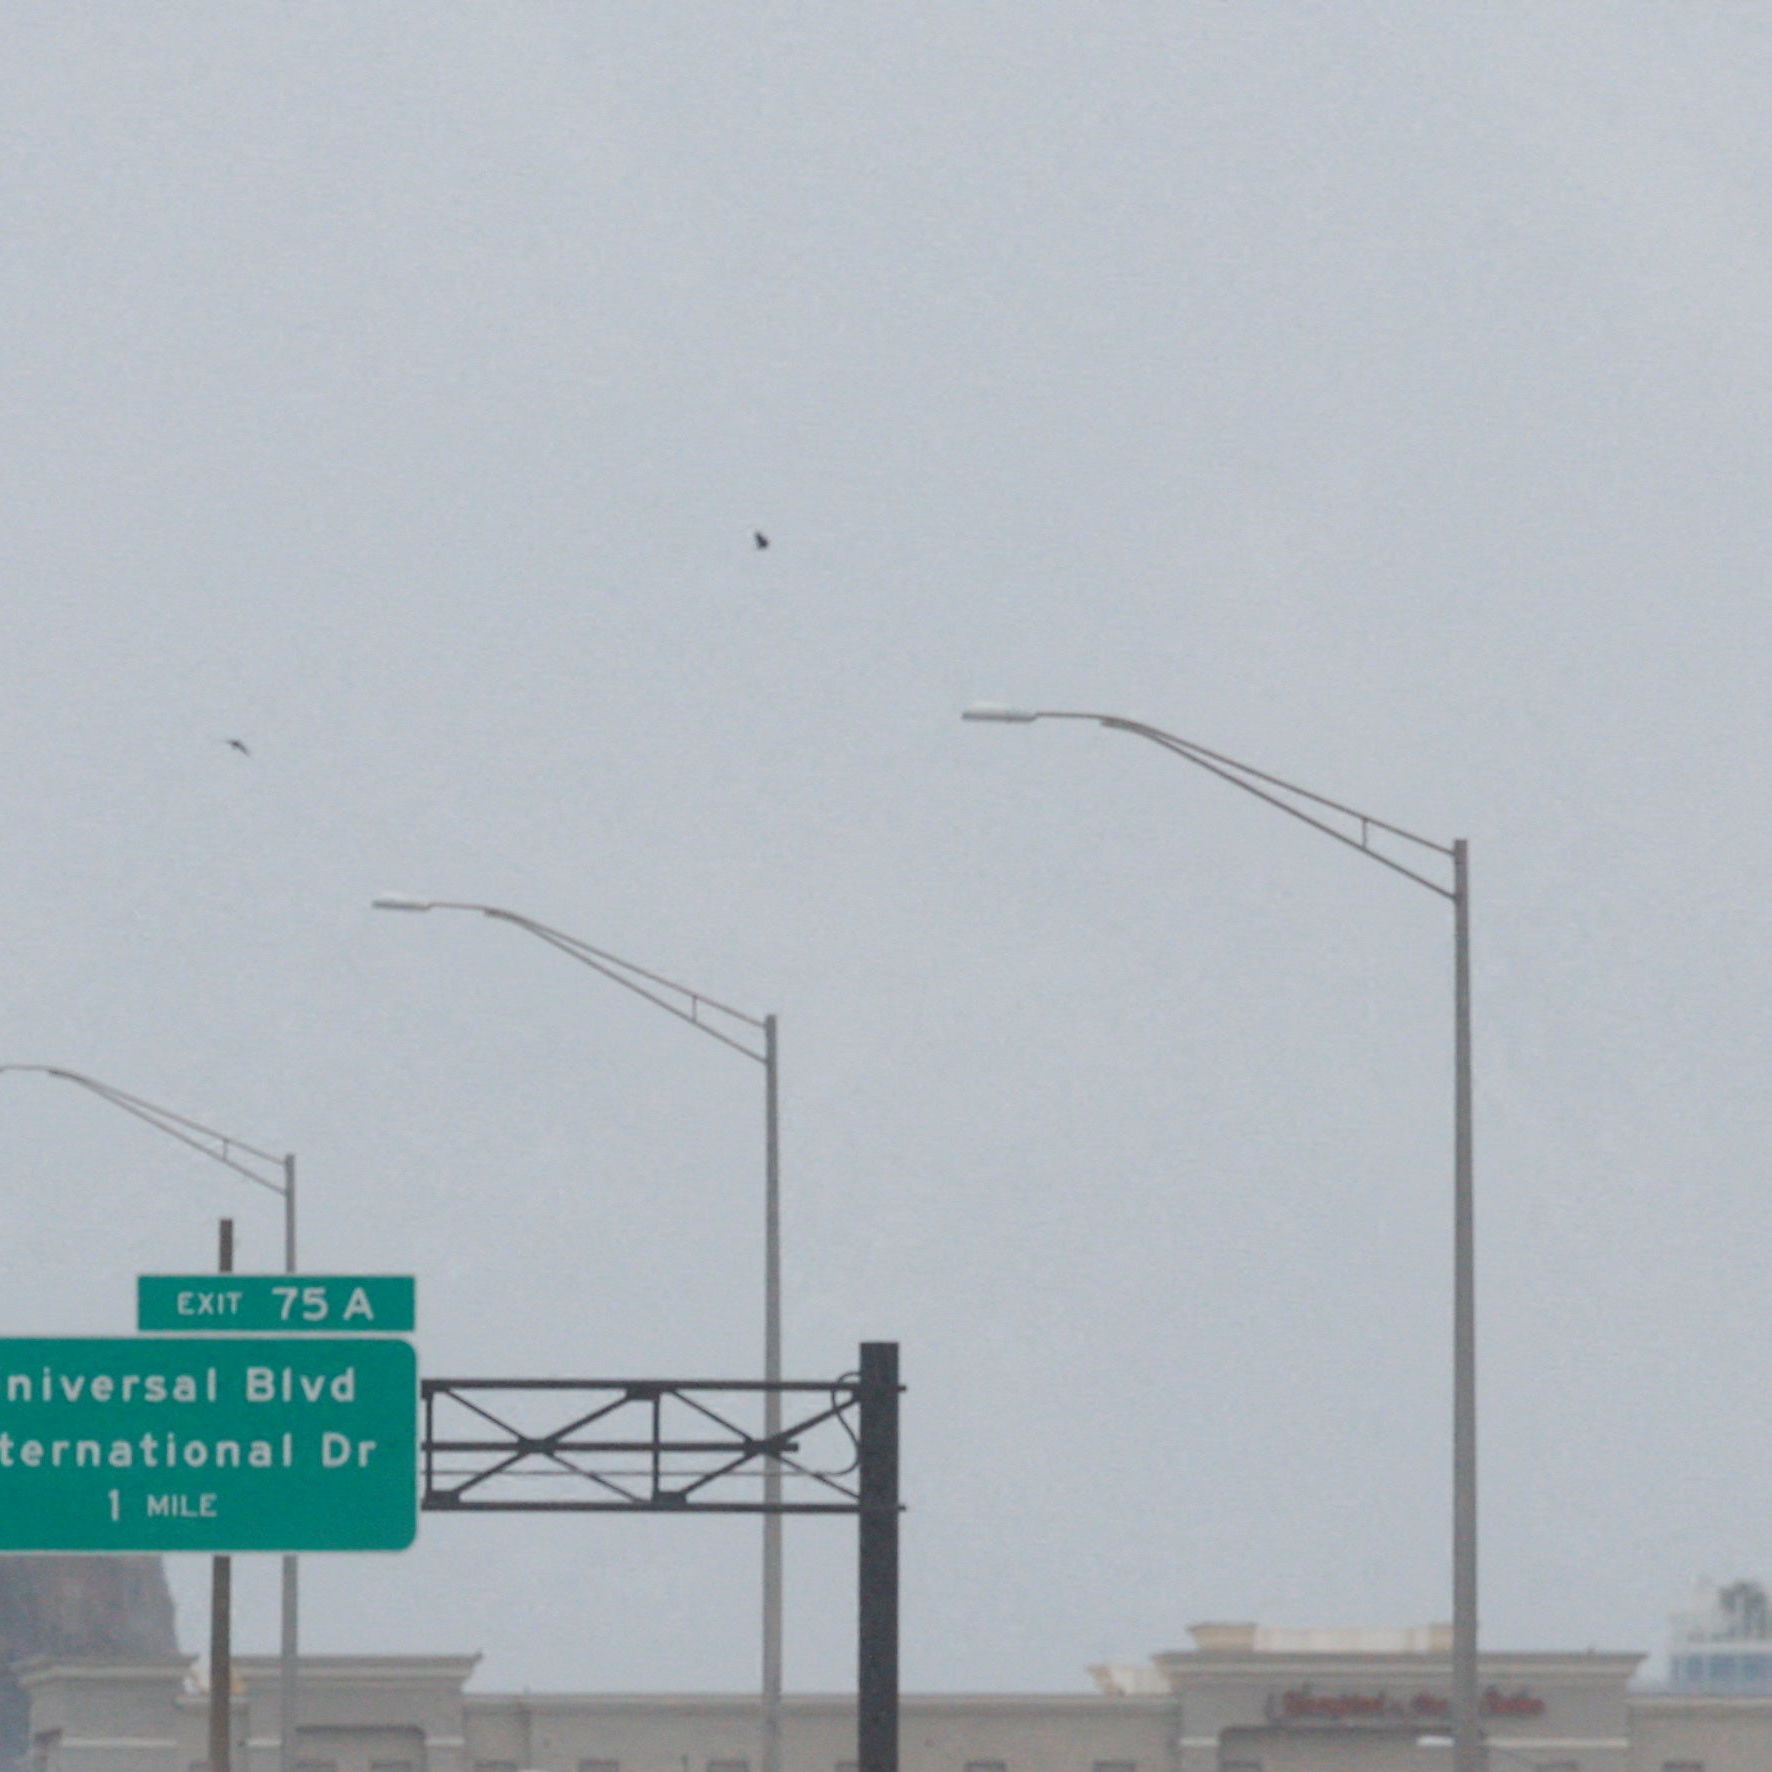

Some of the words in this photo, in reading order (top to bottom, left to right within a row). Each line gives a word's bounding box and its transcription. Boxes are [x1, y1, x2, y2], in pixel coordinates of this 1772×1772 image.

[178, 1292, 241, 1314] EXIT
[273, 1287, 328, 1320] 75
[344, 1288, 373, 1319] A
[247, 1368, 354, 1401] Blvd
[322, 1432, 376, 1467] Dr
[109, 1489, 119, 1520] 1
[148, 1494, 215, 1516] MILE
